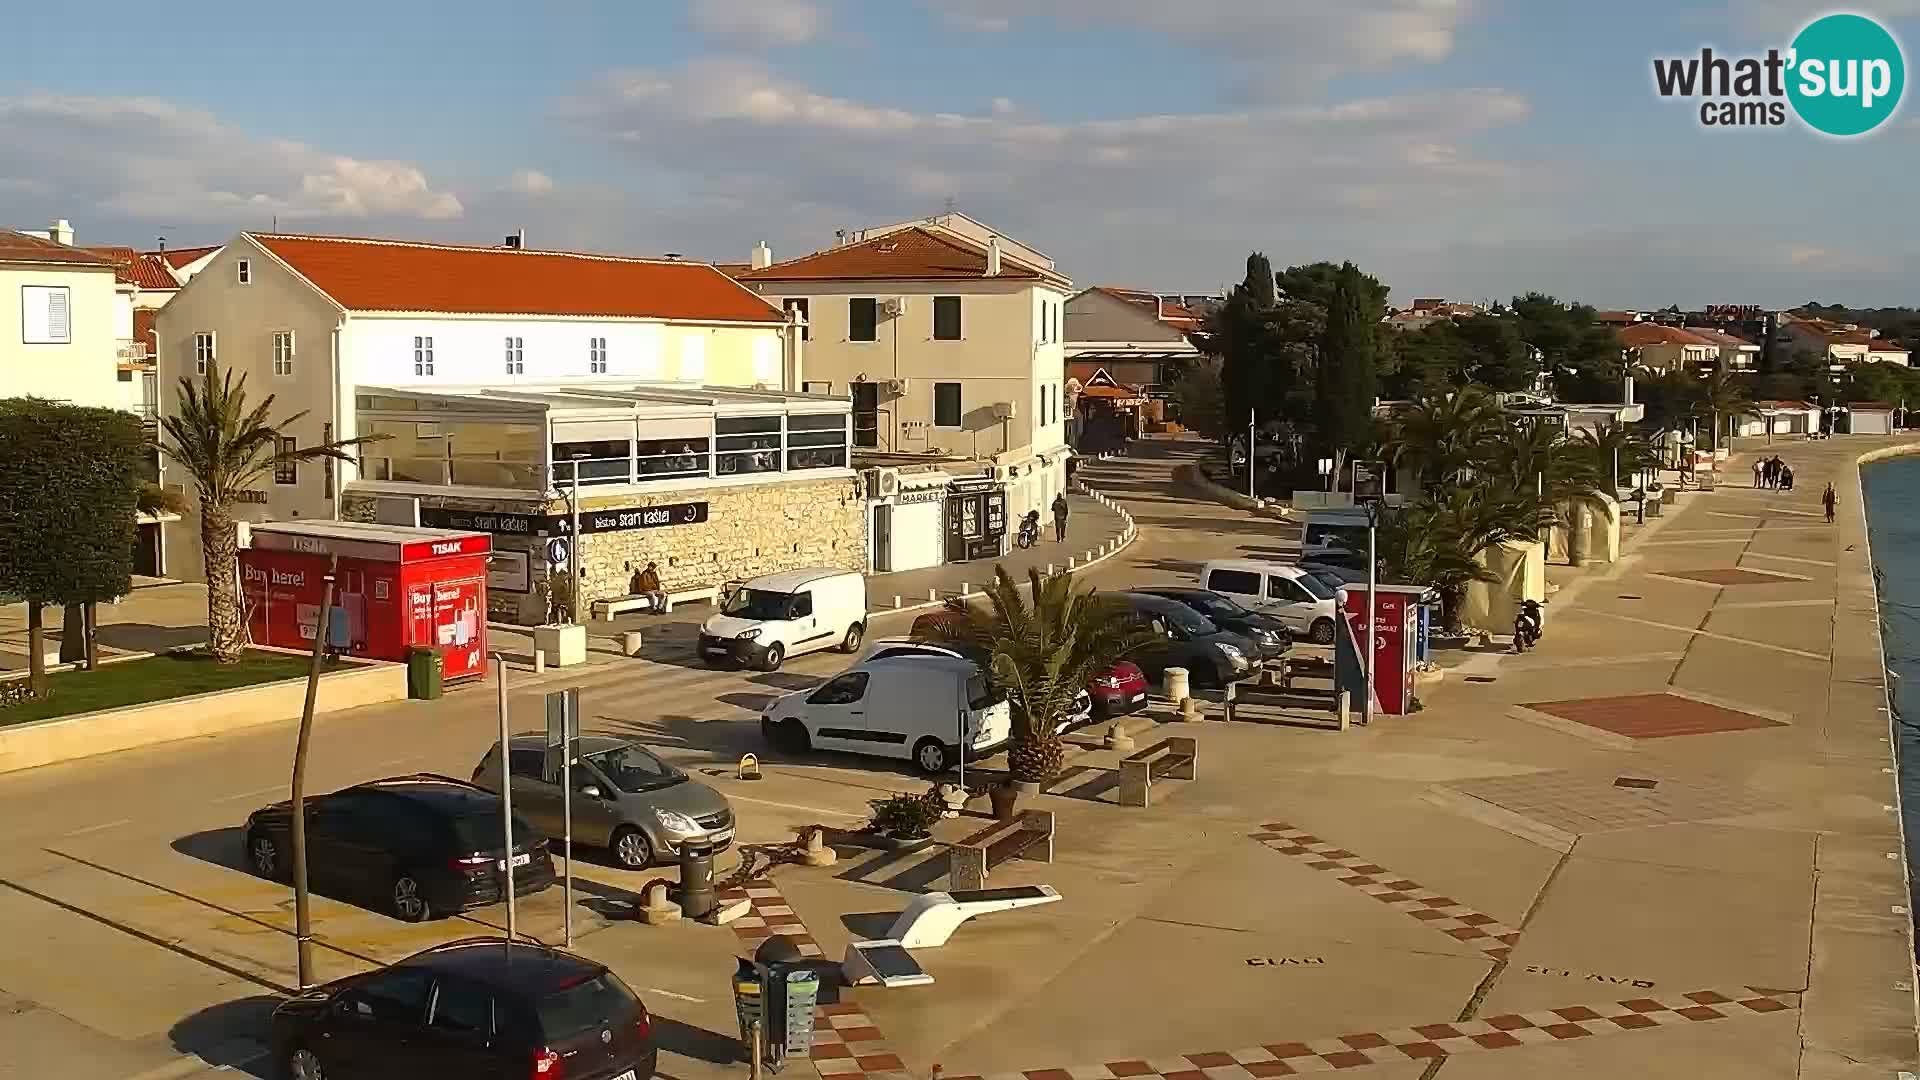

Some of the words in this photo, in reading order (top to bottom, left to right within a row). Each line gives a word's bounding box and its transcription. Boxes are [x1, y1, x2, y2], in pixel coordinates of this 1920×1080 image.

[902, 491, 939, 503] MARKET
[595, 516, 617, 529] bistro
[431, 541, 462, 555] TISAK
[245, 565, 267, 582] Buy
[271, 567, 305, 587] here!
[413, 593, 431, 604] Buy
[437, 588, 460, 601] here!
